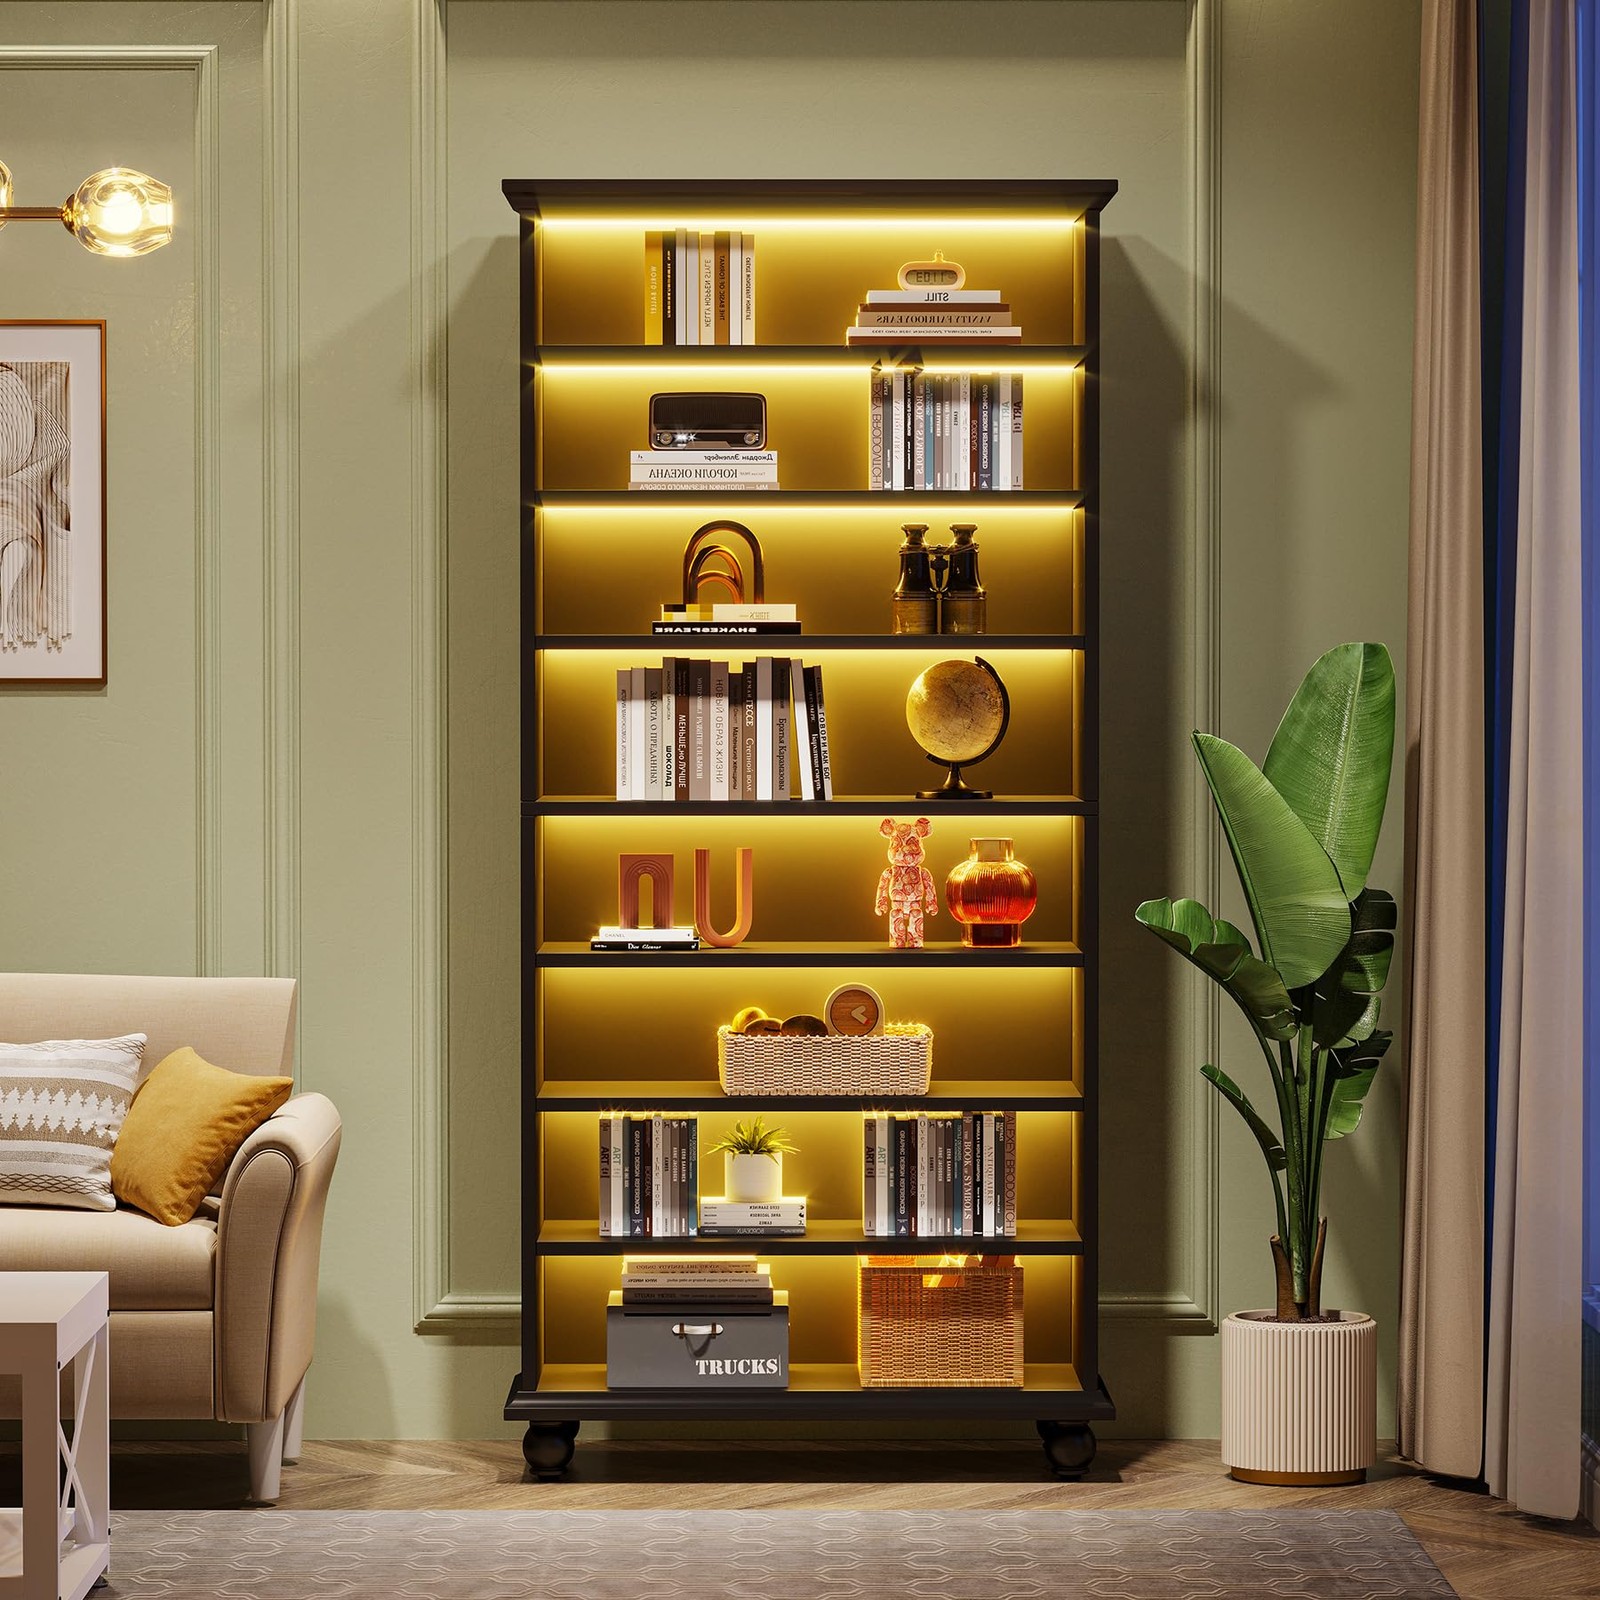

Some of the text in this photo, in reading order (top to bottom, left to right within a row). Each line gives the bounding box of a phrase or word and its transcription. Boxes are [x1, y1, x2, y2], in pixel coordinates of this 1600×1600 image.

[715, 680, 724, 713] НОВЫЙ
[745, 700, 754, 727] ГЕССЕ
[819, 712, 827, 747] ГОВОРИ
[776, 718, 786, 744] Братья
[745, 738, 754, 772] Степной
[776, 745, 787, 790] Карамазовы
[866, 1146, 874, 1165] ART
[1006, 1115, 1015, 1228] ALEXEY BRODOVITCH
